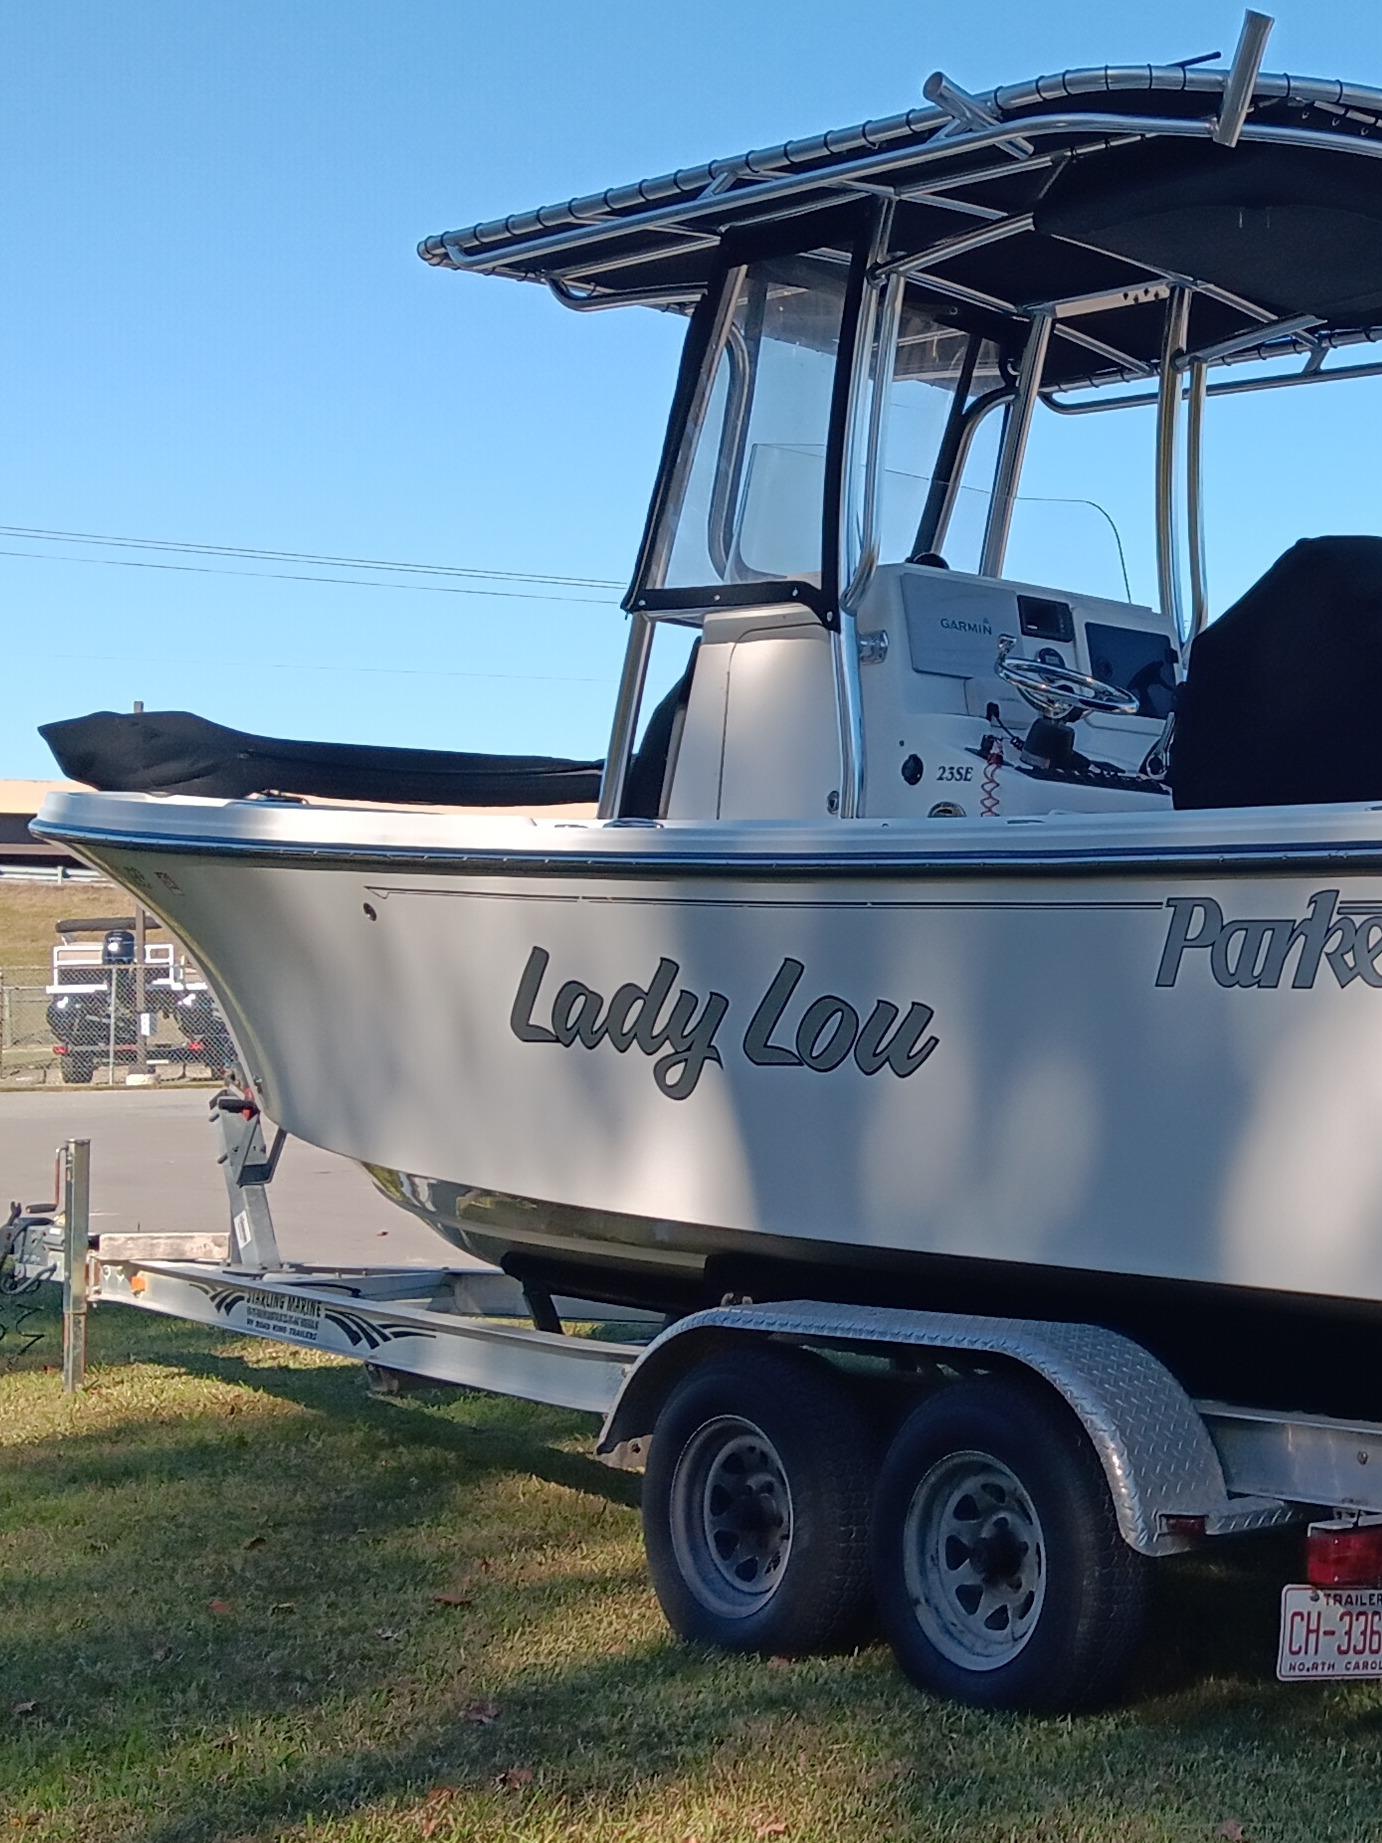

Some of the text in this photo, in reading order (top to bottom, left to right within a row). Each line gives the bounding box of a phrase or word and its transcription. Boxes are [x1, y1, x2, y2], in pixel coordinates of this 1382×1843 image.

[940, 618, 992, 635] GARMIN
[936, 765, 973, 782] 23SE
[510, 946, 940, 1100] Lady Lou
[1288, 1661, 1336, 1673] NORTH
